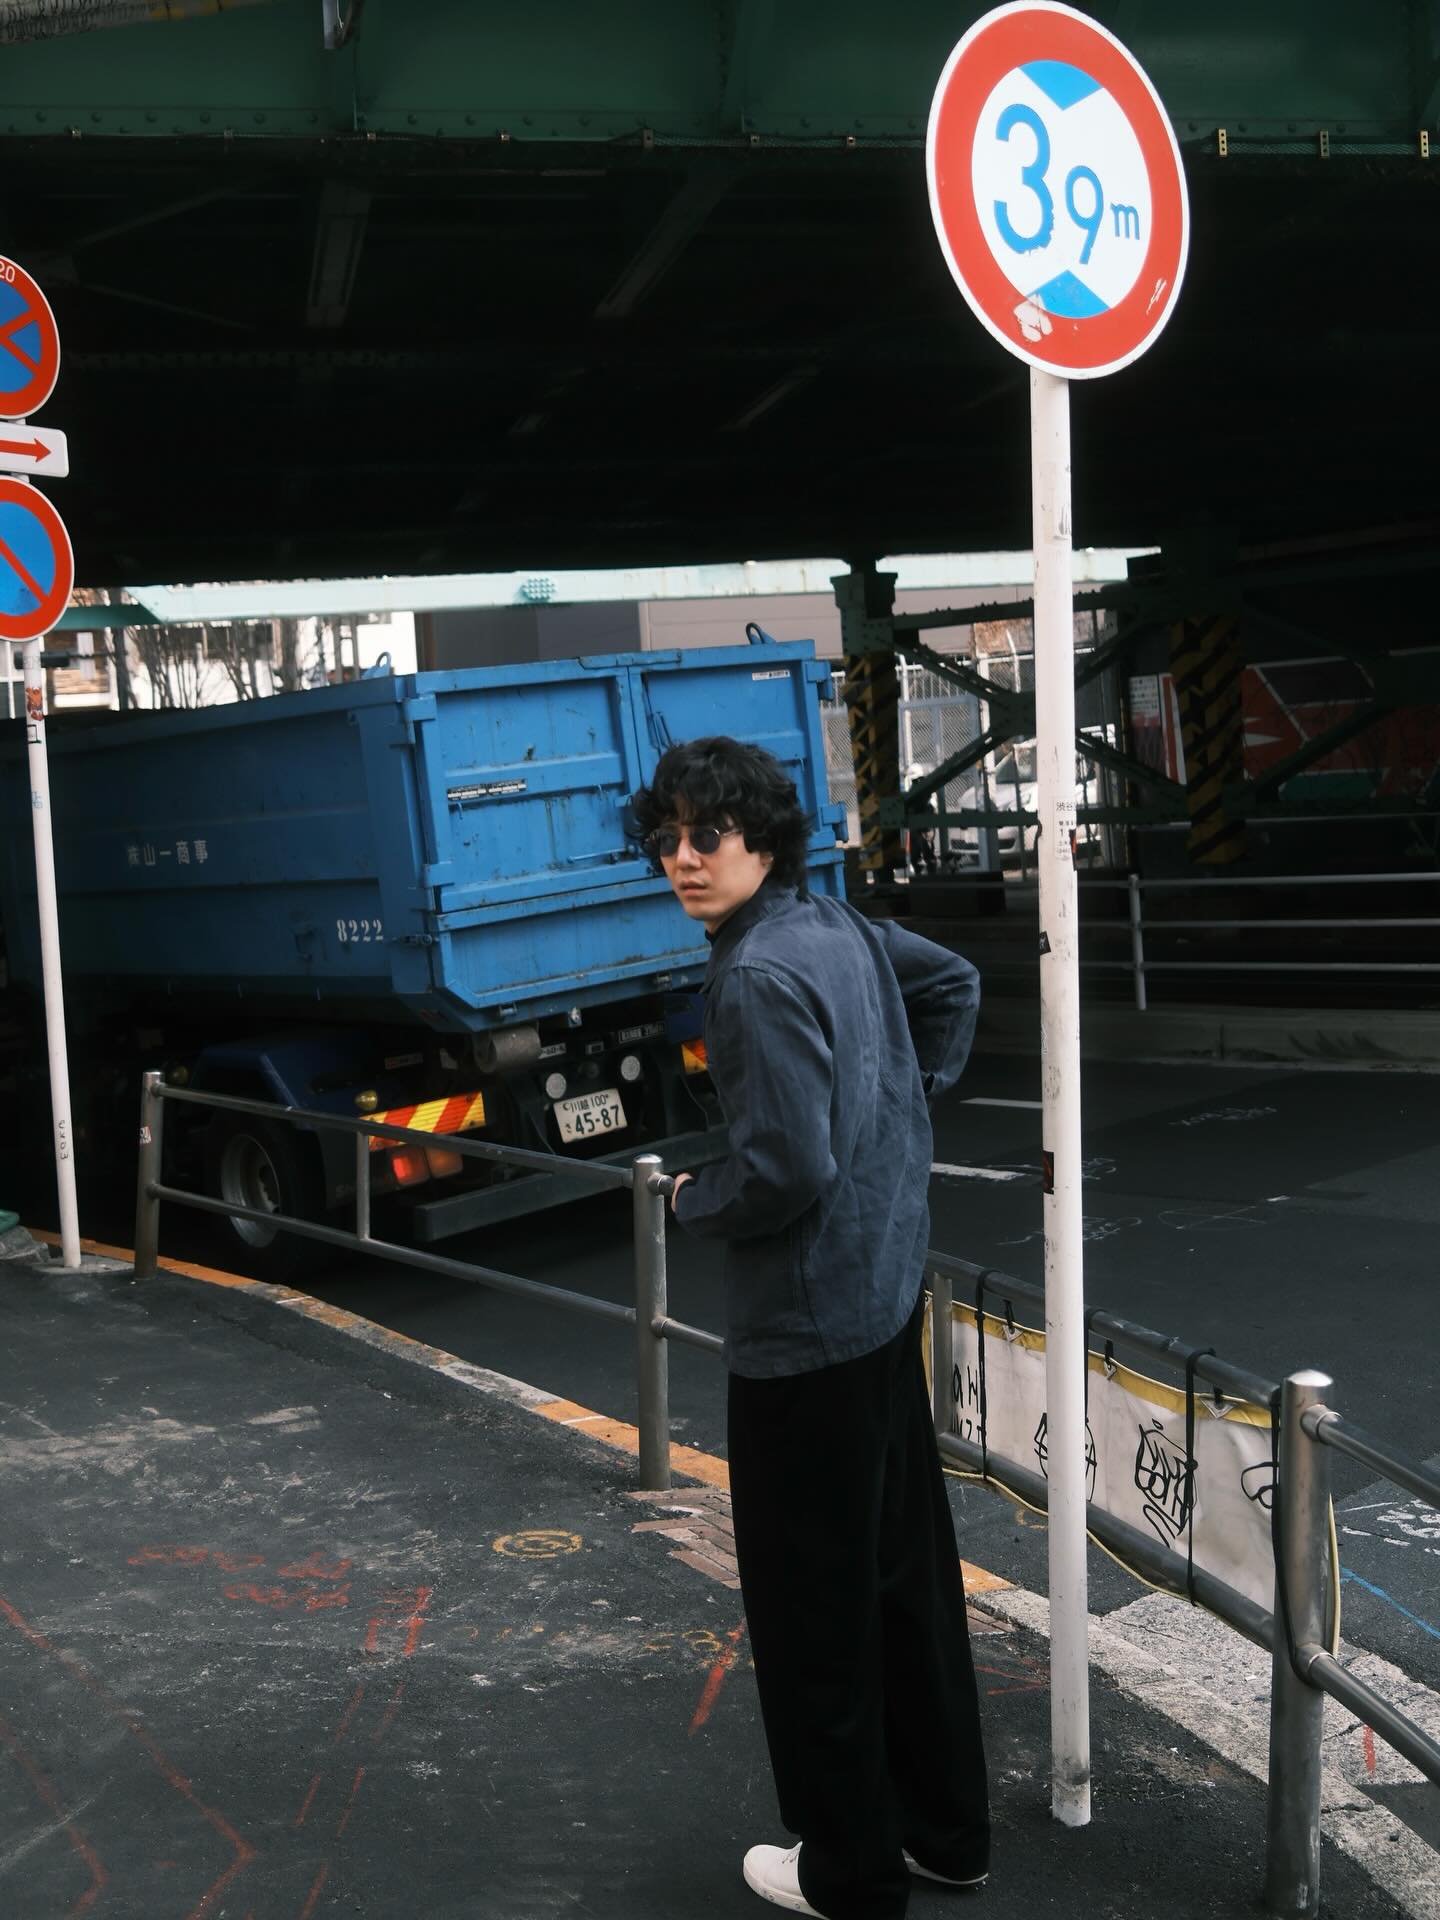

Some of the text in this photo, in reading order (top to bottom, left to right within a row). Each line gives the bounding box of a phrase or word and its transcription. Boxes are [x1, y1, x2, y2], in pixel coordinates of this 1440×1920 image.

[336, 918, 384, 942] 8222
[591, 1094, 607, 1108] 100
[575, 1104, 619, 1134] 45-87
